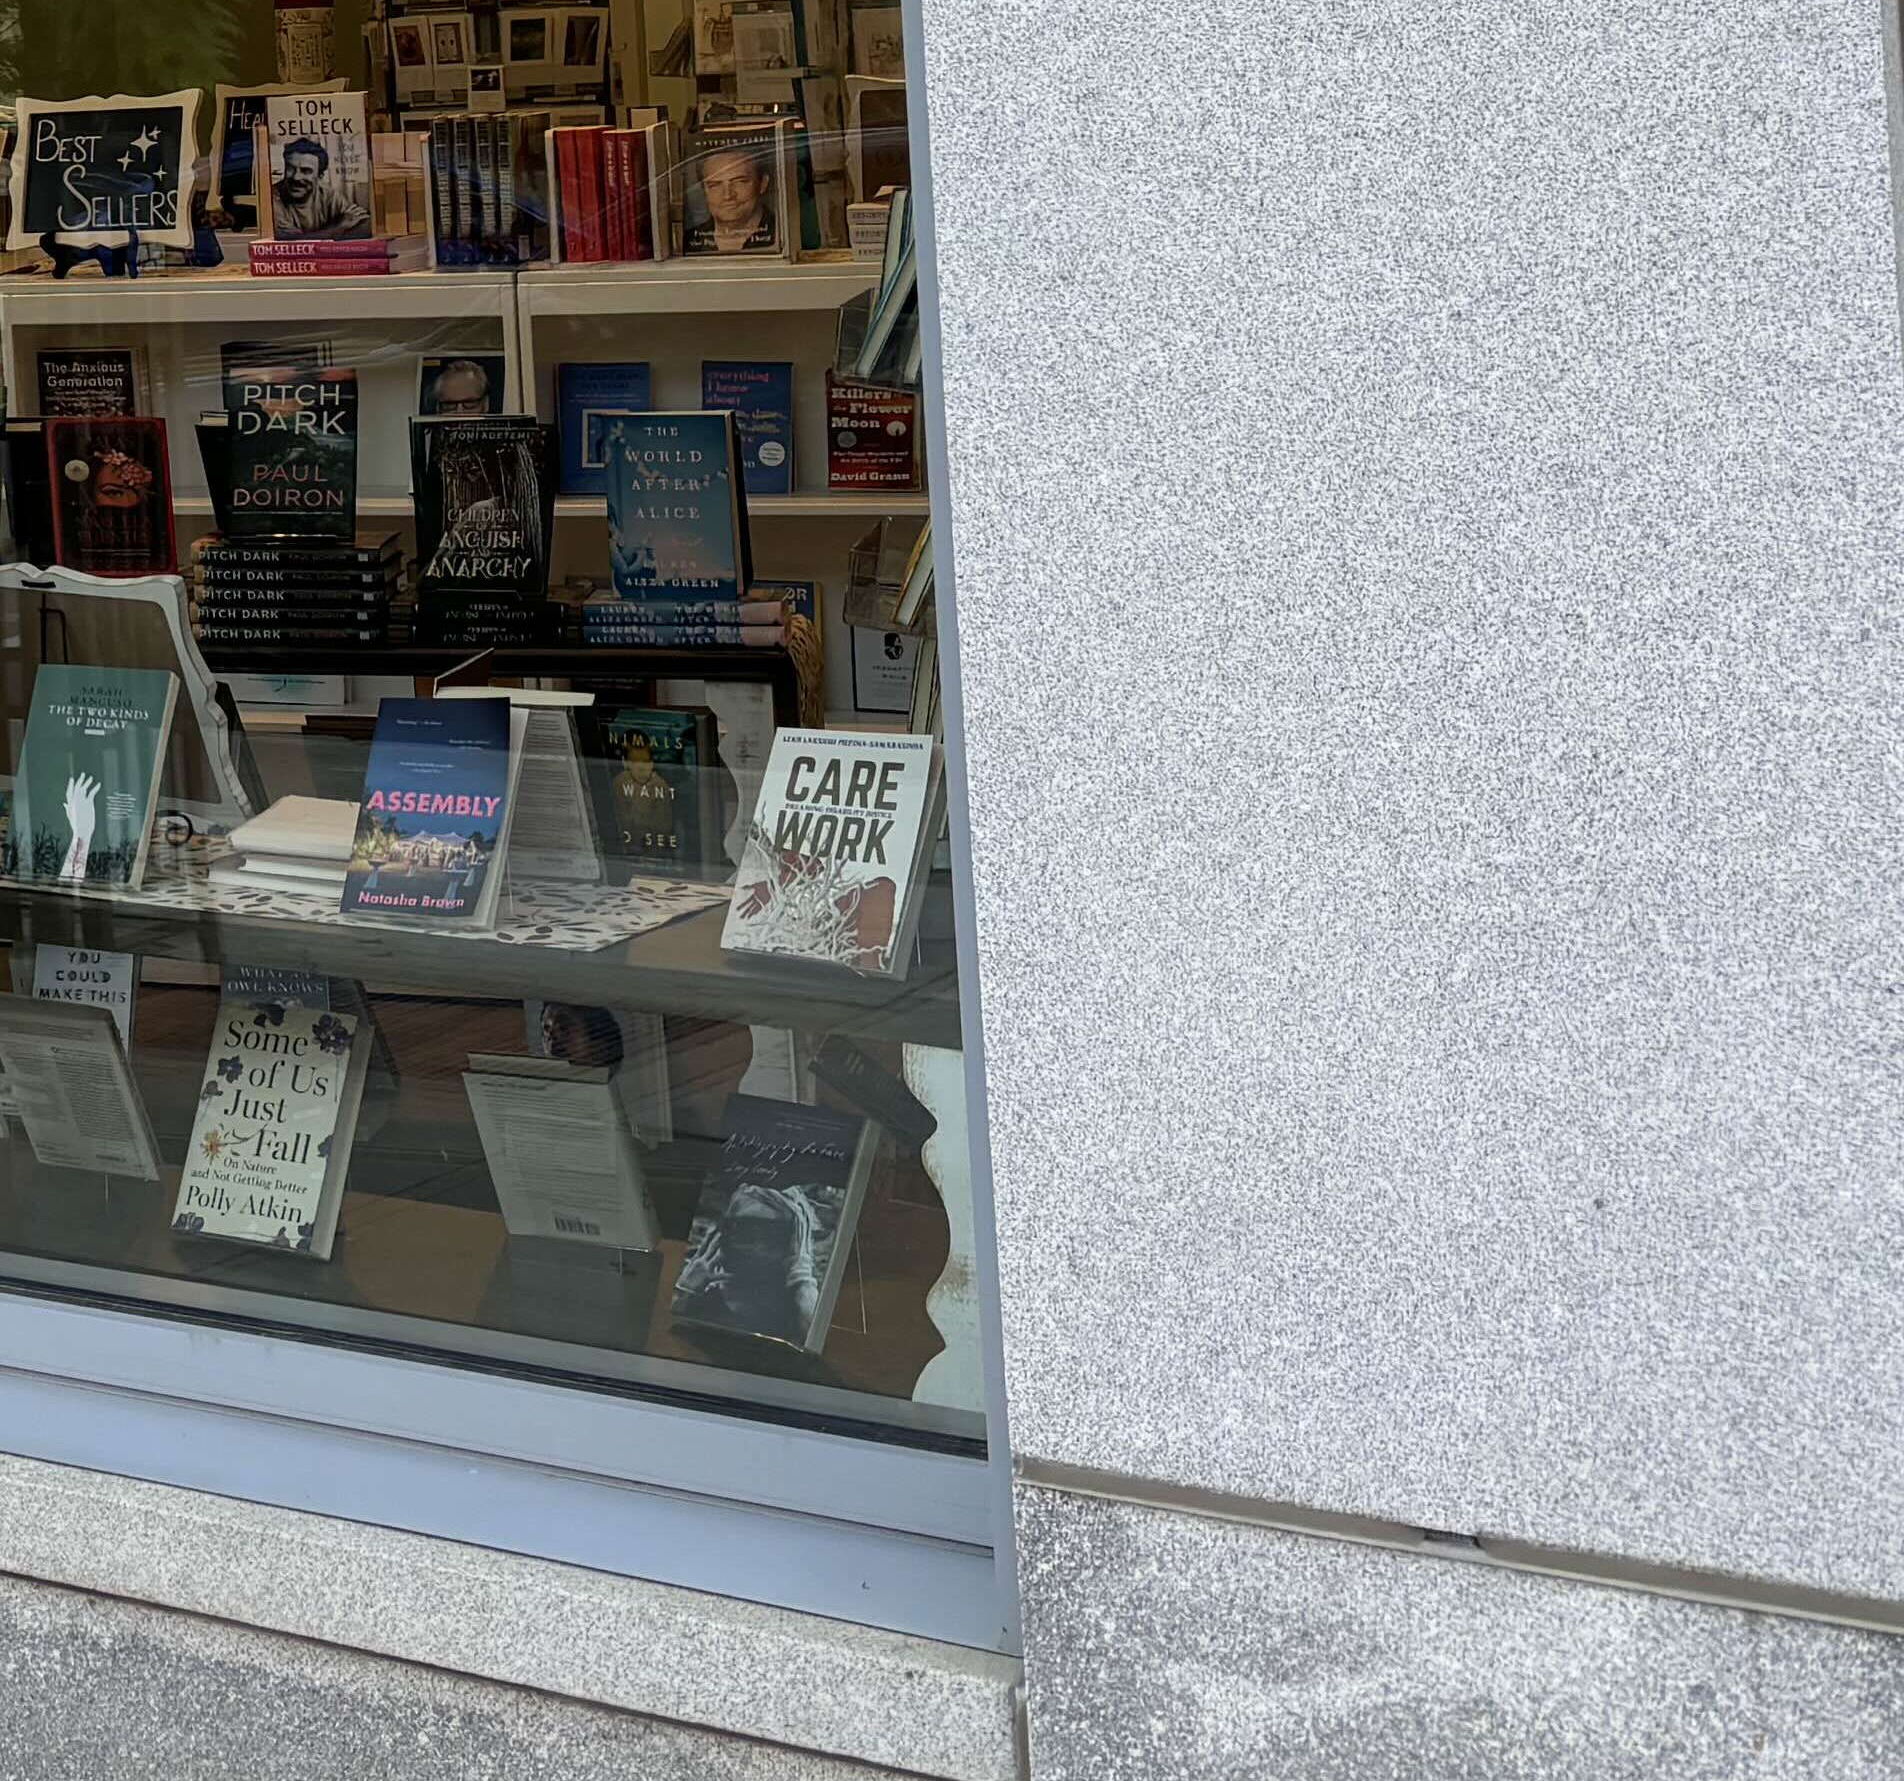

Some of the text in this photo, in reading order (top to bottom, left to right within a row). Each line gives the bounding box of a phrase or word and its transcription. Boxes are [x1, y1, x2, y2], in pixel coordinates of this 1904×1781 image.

[295, 100, 332, 117] TOM
[278, 118, 353, 137] SELLECK
[35, 119, 103, 163] BEST
[58, 164, 178, 231] SELLERS
[251, 243, 316, 256] TOM SELLECK
[253, 261, 317, 274] TOM SELLECK
[43, 361, 125, 375] The Anxious
[243, 383, 341, 407] PITCH
[831, 388, 892, 400] Killers
[849, 403, 912, 416] Flower
[237, 410, 347, 436] DARK
[644, 426, 680, 437] THE
[830, 418, 881, 429] Moon
[624, 449, 703, 464] WORLD
[253, 463, 328, 483] PAUL
[830, 472, 910, 482] David Grann
[631, 478, 700, 492] AFTER
[232, 488, 344, 508] DOIRON
[447, 508, 520, 522] CHILDREN
[635, 507, 701, 520] ALICE
[438, 530, 522, 550] ANGUISH
[242, 549, 280, 561] DARK
[246, 569, 284, 582] DARK
[425, 556, 532, 579] ANARCHY
[671, 577, 720, 589] GREEN
[247, 588, 285, 601] DARK
[242, 607, 279, 620] DARK
[243, 627, 281, 640] DARK
[47, 704, 150, 720] THE TWO KINDS
[65, 716, 129, 730] OF DECAY
[608, 731, 683, 750] NIMALS
[785, 755, 906, 811] CARE
[622, 783, 677, 801] WANT
[366, 789, 501, 818] ASSEMBLY
[645, 832, 678, 849] SEE
[774, 809, 896, 866] WORK
[357, 891, 465, 909] Natasha Brown
[66, 951, 101, 965] YOU
[55, 969, 112, 984] COULD
[38, 988, 127, 1004] MAKE THIS
[223, 1019, 309, 1057] Some
[248, 1060, 330, 1097] of Us
[223, 1088, 287, 1124] Just
[254, 1127, 312, 1165] Fall
[222, 1156, 279, 1176] On Nature
[191, 1167, 308, 1196] and Not Getting Better
[185, 1185, 303, 1224] Polly Atkin
